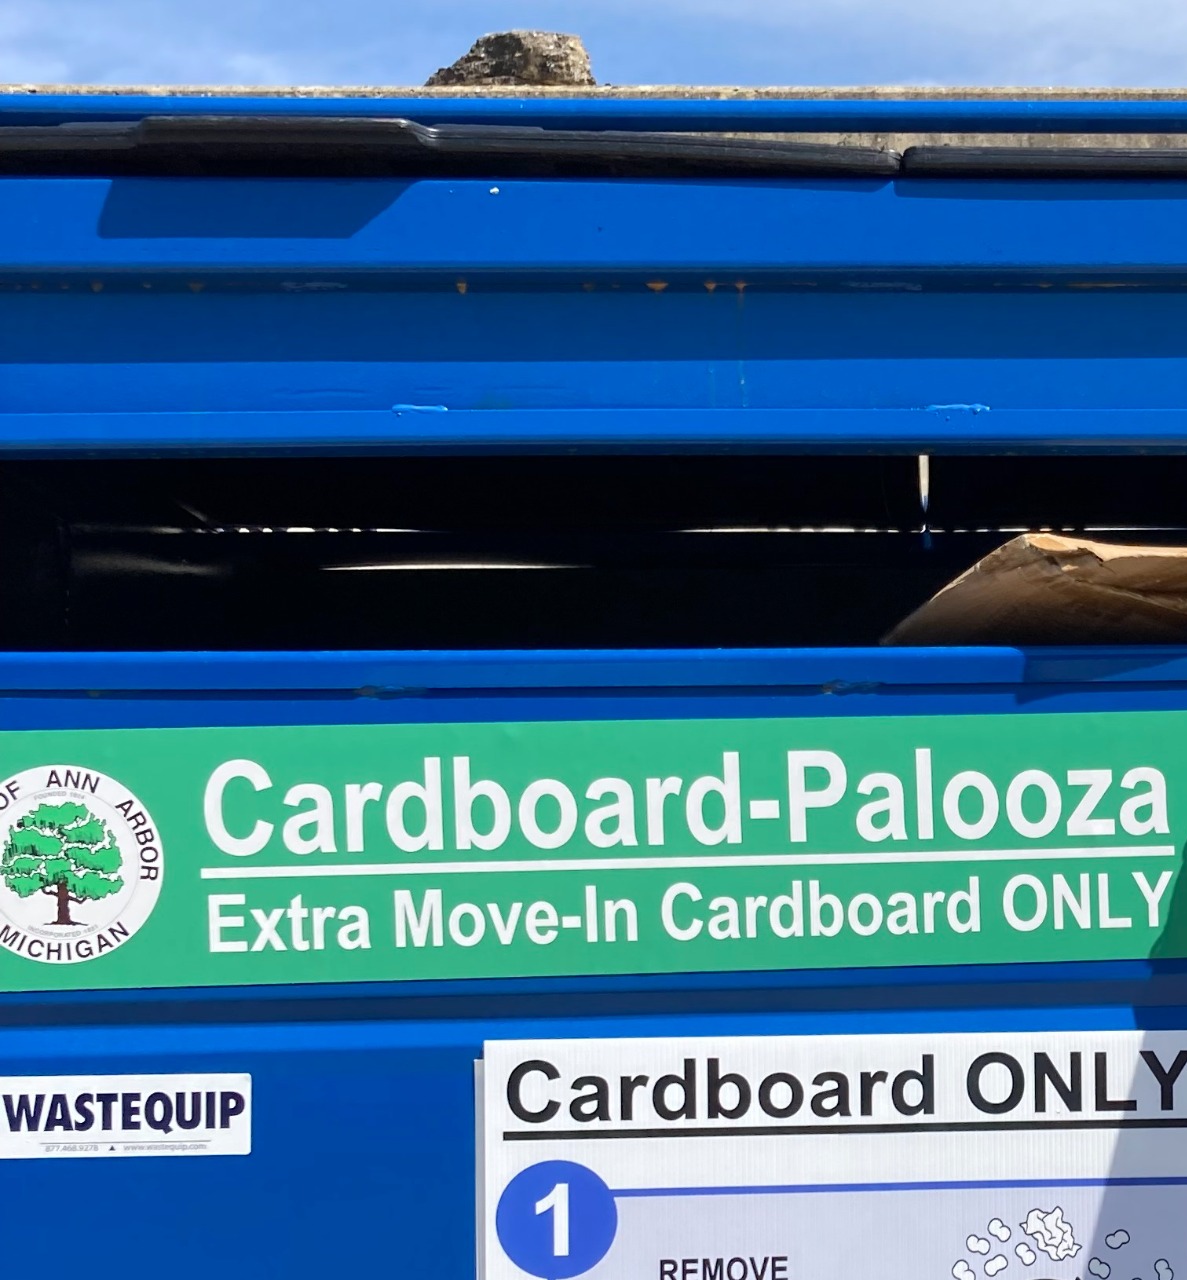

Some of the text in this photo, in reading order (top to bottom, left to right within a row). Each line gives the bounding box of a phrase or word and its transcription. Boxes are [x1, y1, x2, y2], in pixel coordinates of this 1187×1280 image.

[46, 769, 100, 794] ANN
[115, 799, 160, 881] ARBOR
[203, 747, 1171, 857] Cardboard-Palooza
[0, 921, 130, 961] MICHIGAN
[207, 870, 1175, 953] Extra Move-In Cardboard ONLY
[2, 1091, 246, 1135] WASTEQUIP
[505, 1053, 936, 1126] Cardboard
[533, 1183, 572, 1257] 1
